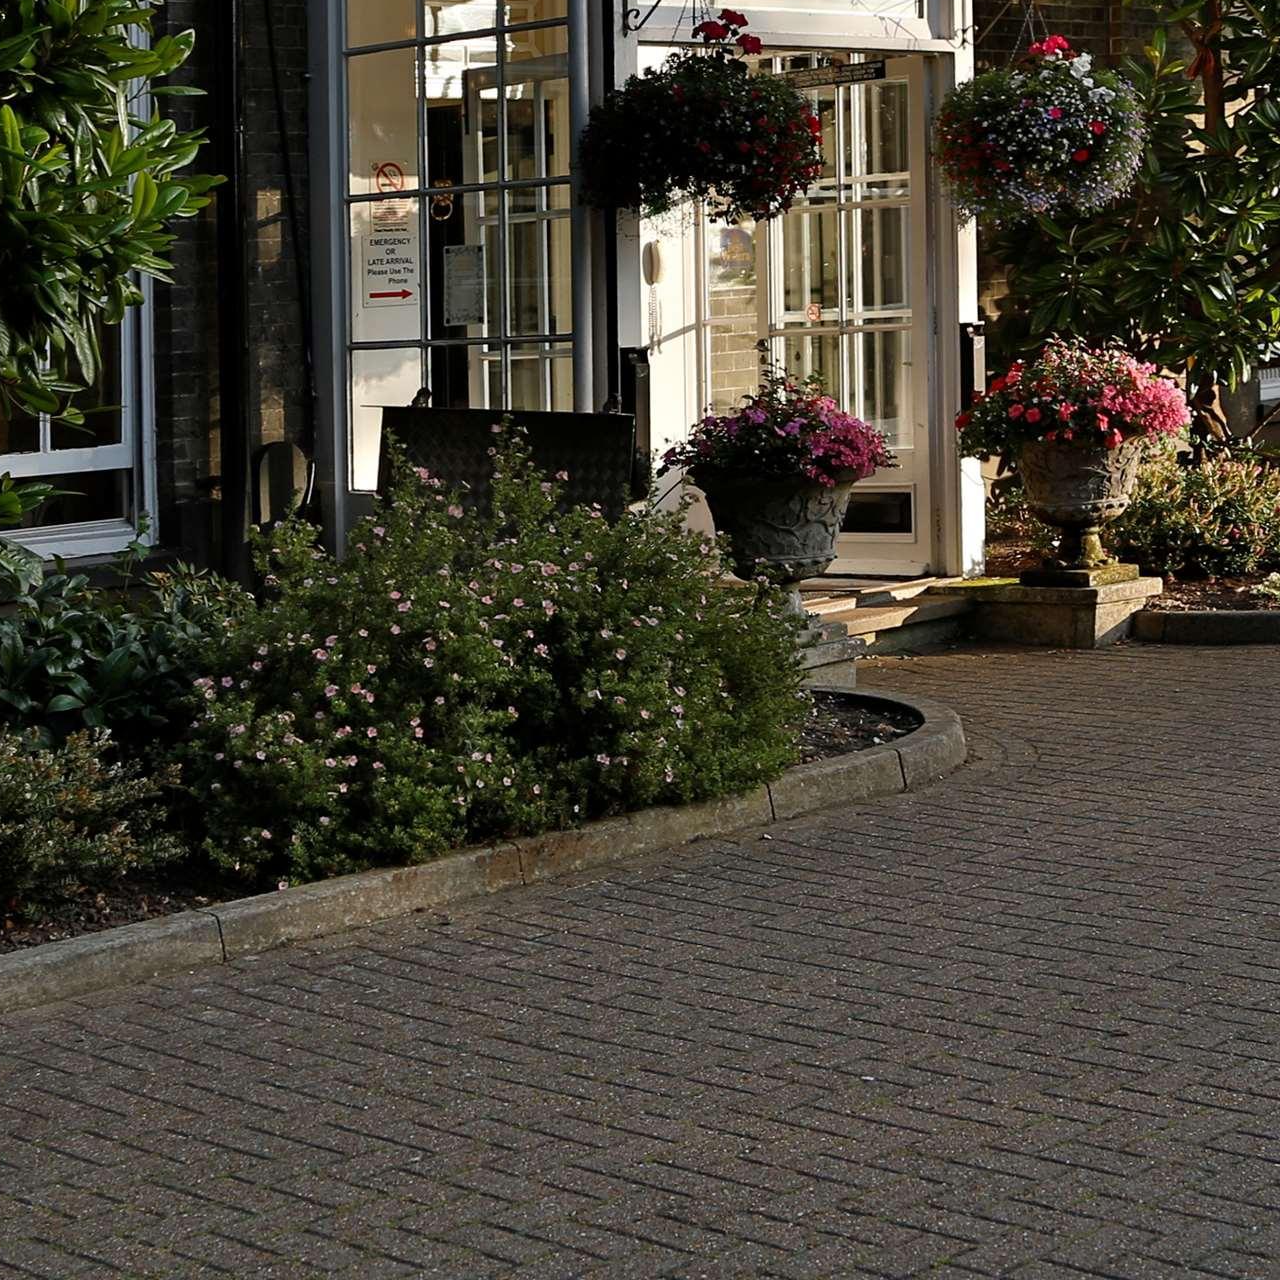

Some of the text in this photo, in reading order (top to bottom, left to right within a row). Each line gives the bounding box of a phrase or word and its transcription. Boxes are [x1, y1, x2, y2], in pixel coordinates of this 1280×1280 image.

[369, 237, 411, 247] EMERGENCY
[368, 257, 414, 266] LATE ARRIVAL
